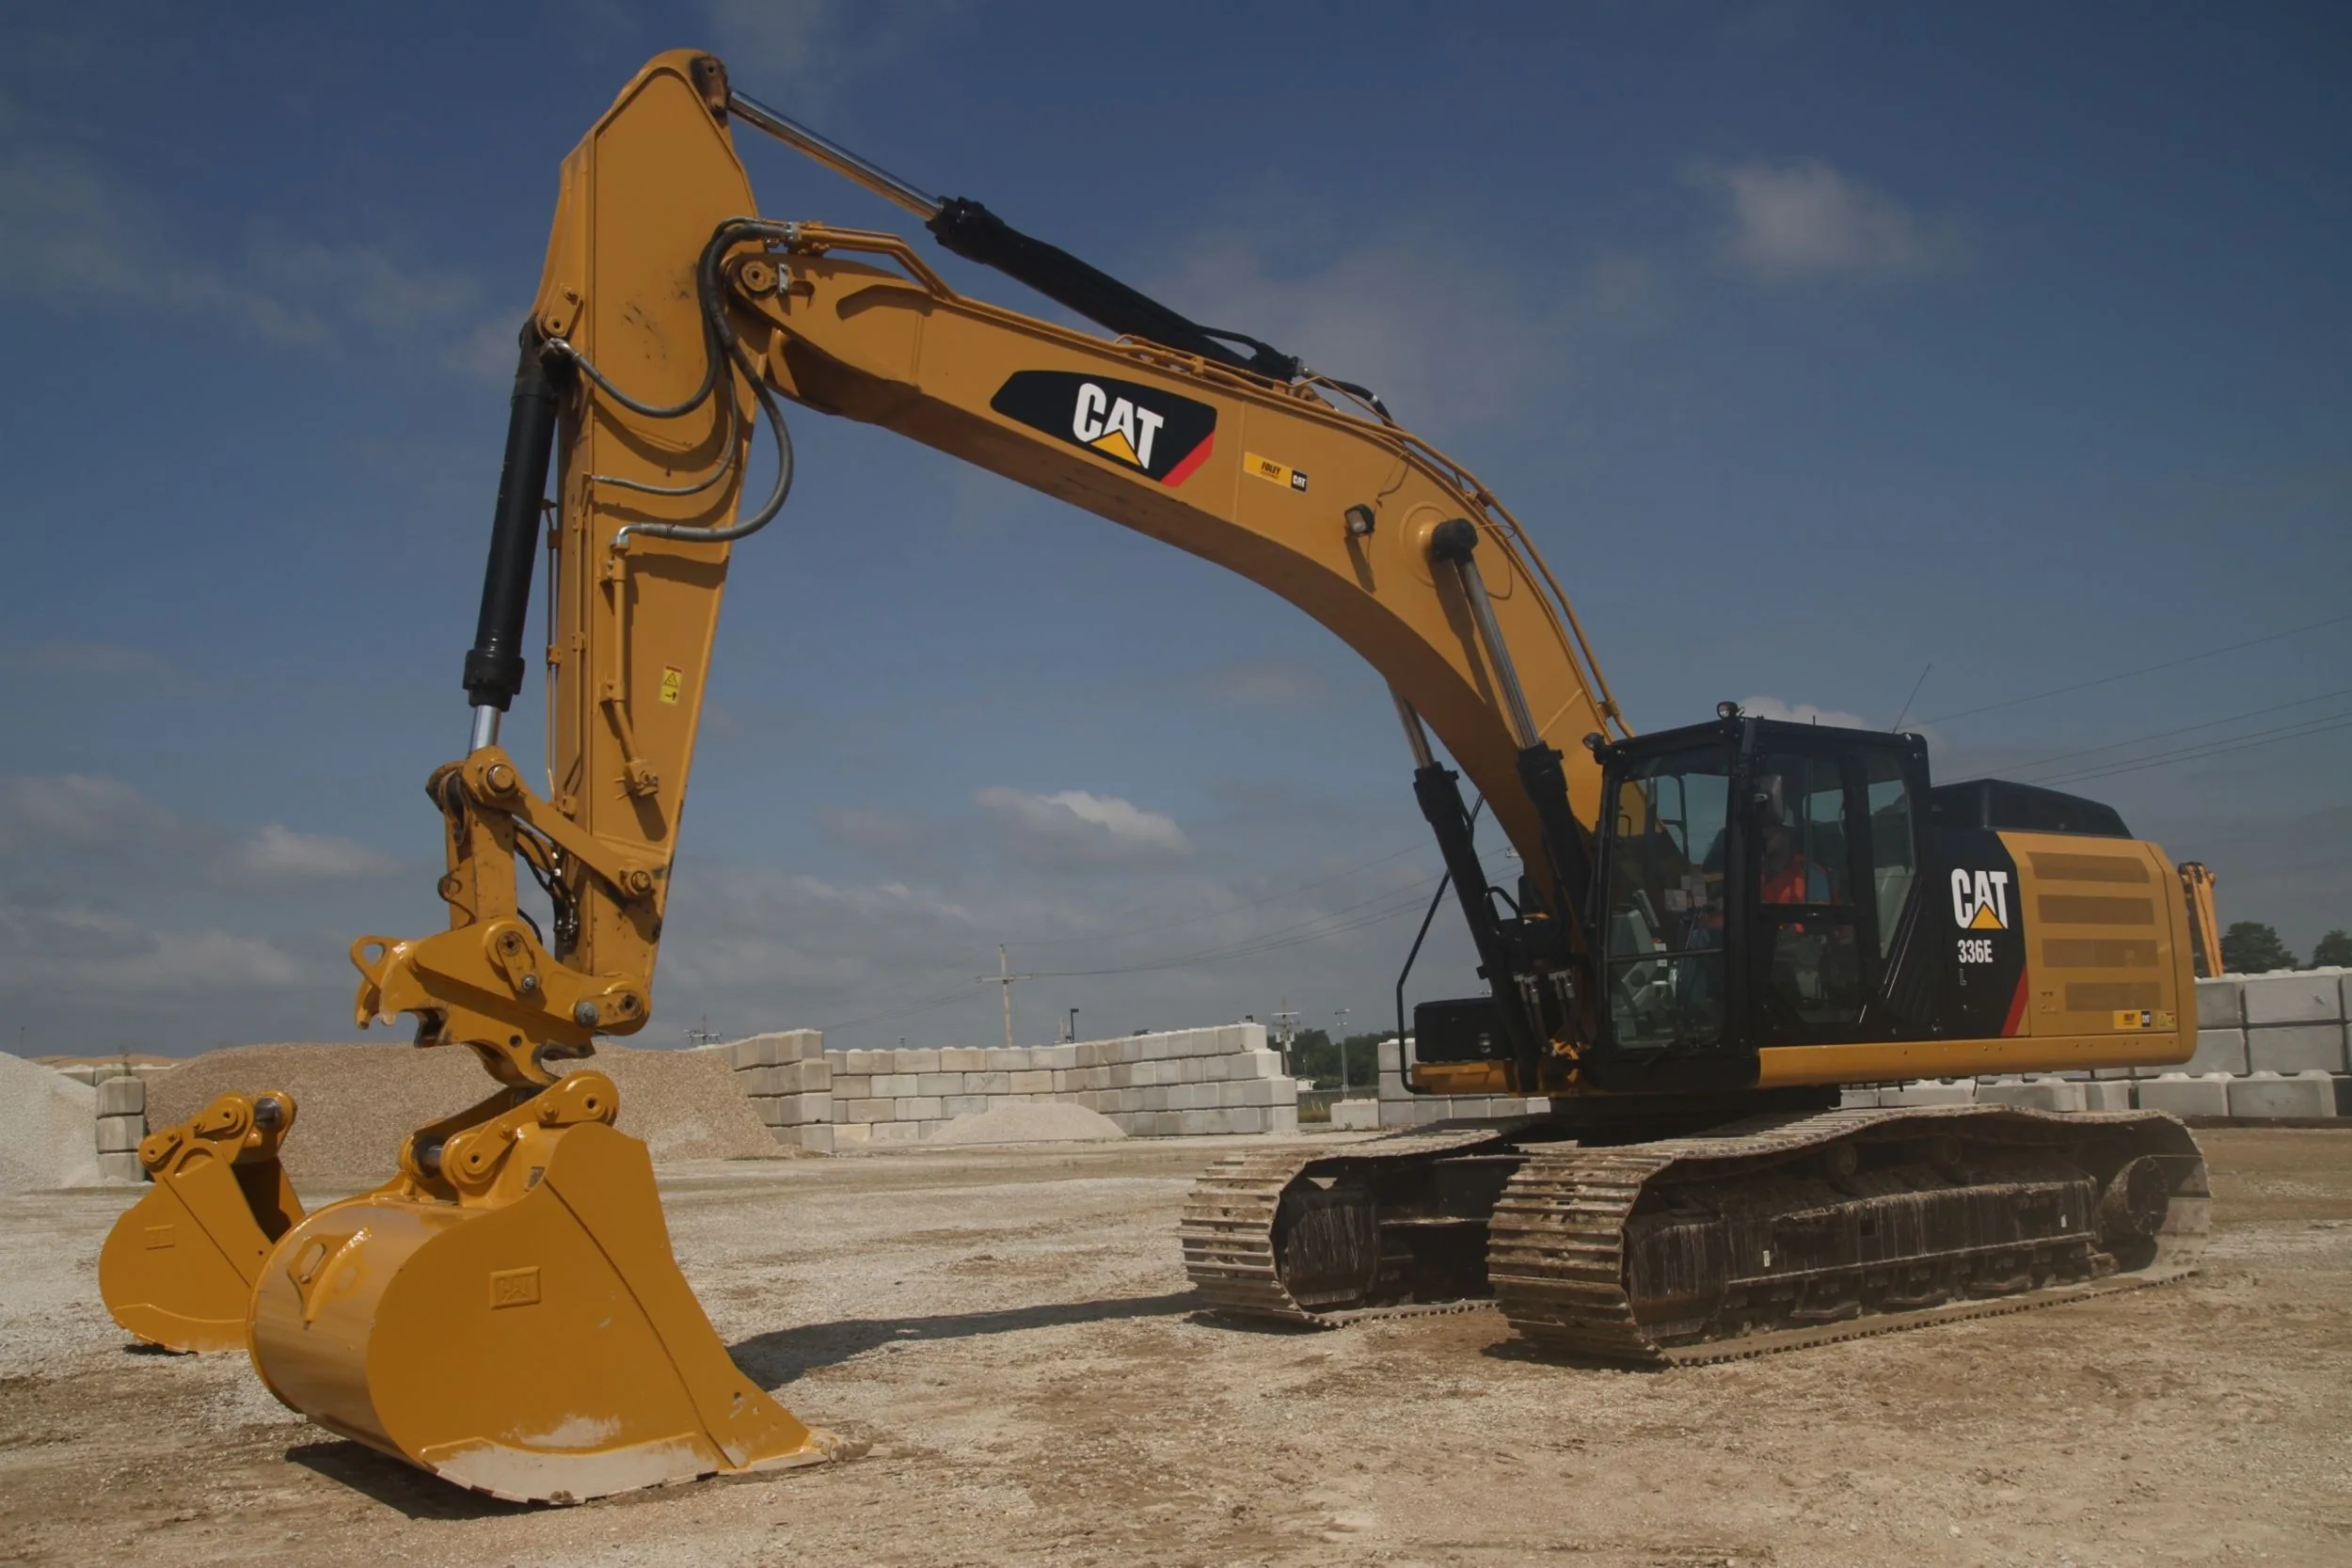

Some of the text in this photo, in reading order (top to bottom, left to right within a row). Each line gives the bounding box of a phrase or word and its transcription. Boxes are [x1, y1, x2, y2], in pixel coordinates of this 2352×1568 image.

[1073, 383, 1164, 469] CAT
[1293, 474, 1307, 488] CAT
[1950, 867, 2009, 929] CAT
[1958, 939, 1994, 963] 336E
